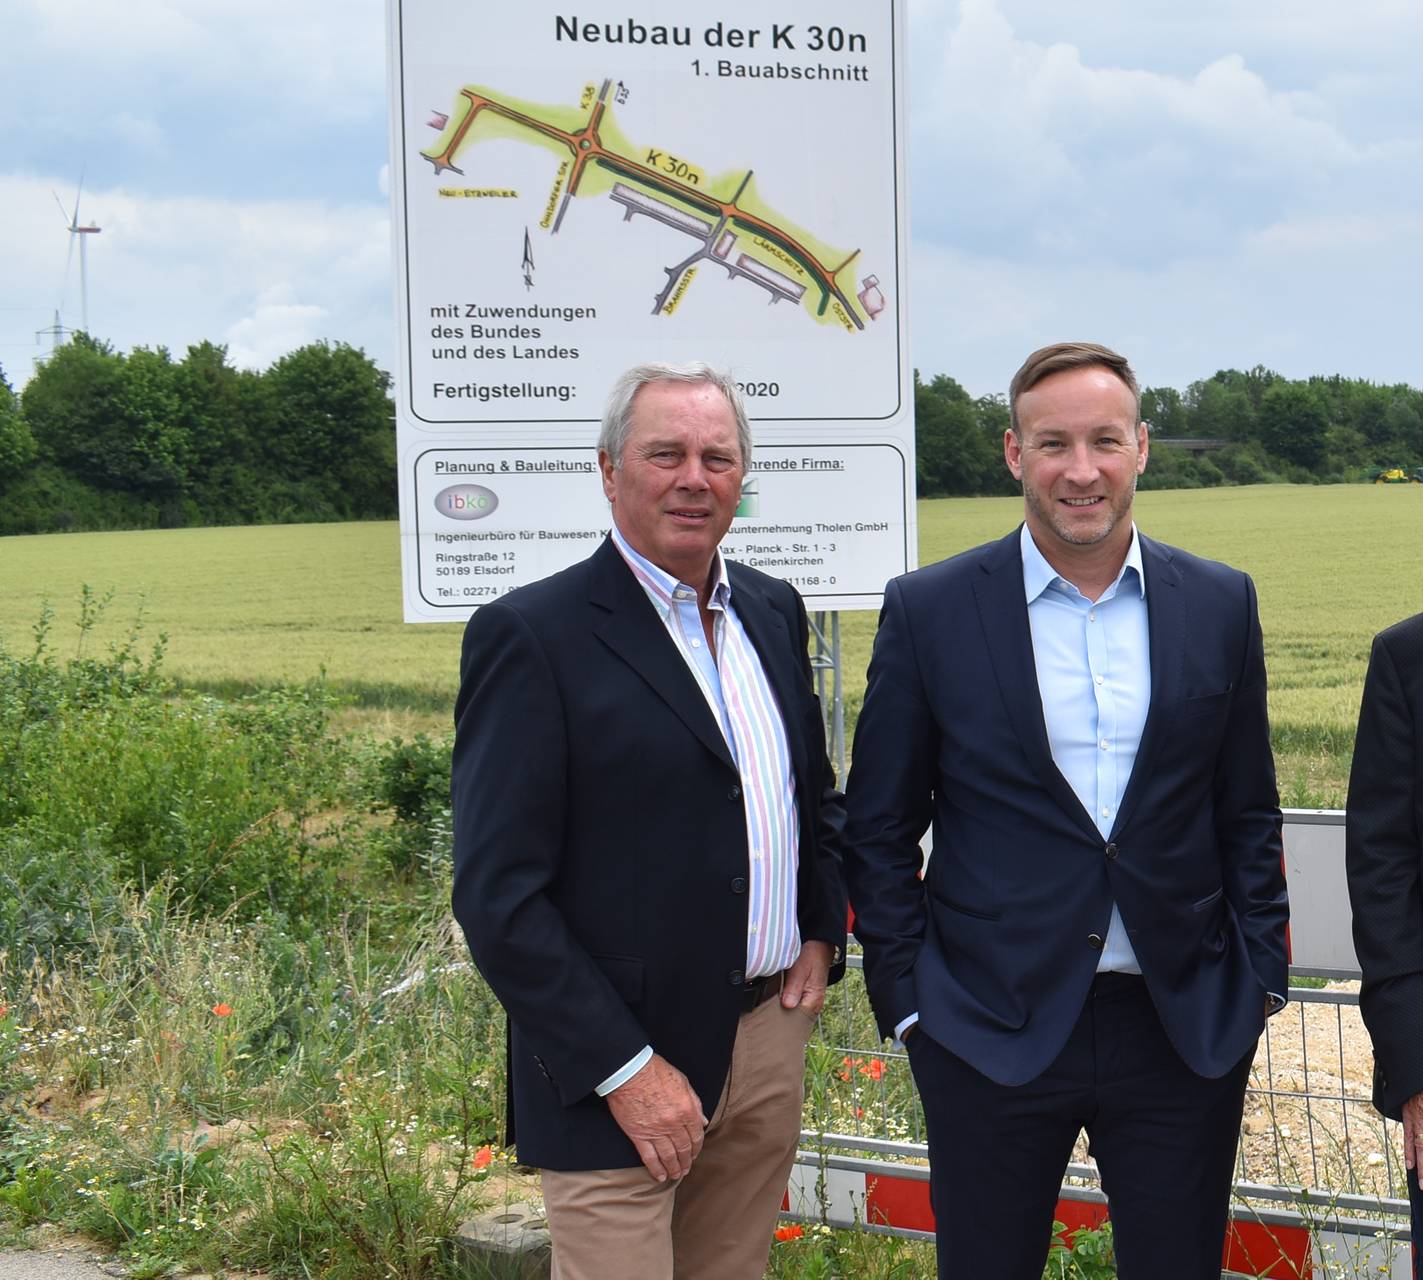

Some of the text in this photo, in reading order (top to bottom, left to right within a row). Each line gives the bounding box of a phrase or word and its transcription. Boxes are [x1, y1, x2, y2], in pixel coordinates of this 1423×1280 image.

[555, 15, 867, 52] Neubau der K 30n
[691, 59, 869, 82] 1. Bauabschnitt
[646, 149, 700, 185] K 30n
[430, 304, 597, 322] mit Zuwendungen
[431, 324, 541, 339] des Bundes
[432, 345, 580, 359] und des Landes
[433, 383, 577, 402] Fertigstellung:
[434, 459, 597, 474] Planung & Bauleitung:
[801, 457, 845, 469] Firma:
[815, 523, 852, 533] Tholen
[855, 522, 889, 532] GmbH
[434, 530, 516, 544] Ingenieurbüro
[519, 530, 535, 541] für
[538, 530, 597, 540] Bauwesen
[746, 544, 782, 554] Planck
[792, 544, 810, 553] Str.
[814, 543, 819, 552] 1
[830, 543, 837, 552] 3
[436, 552, 516, 564] Ringstraße 12
[749, 557, 824, 567] Geilenkirchen
[436, 565, 515, 576] 50189 Elsdorf
[829, 576, 837, 585] 0
[463, 587, 498, 596] 02274
